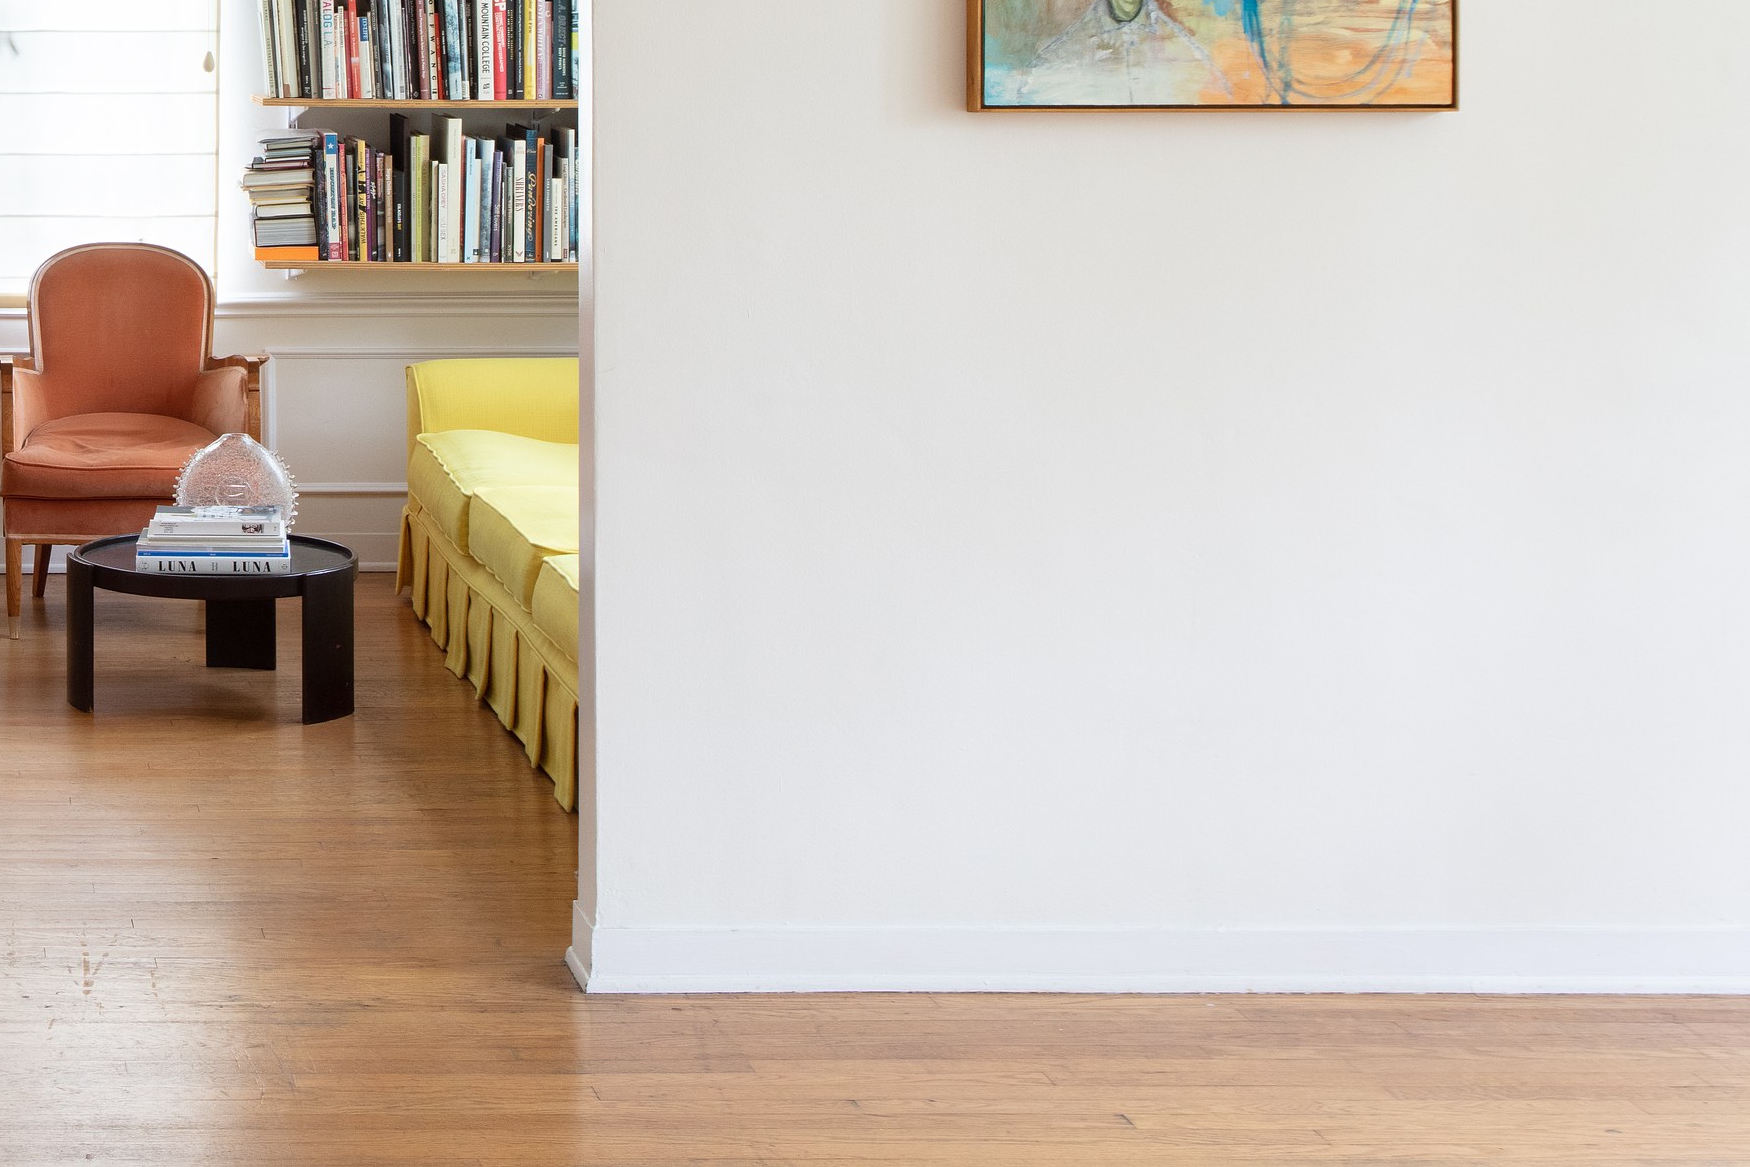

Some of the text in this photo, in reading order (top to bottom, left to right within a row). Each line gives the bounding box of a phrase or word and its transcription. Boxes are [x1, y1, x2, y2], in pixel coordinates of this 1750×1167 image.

[481, 2, 489, 39] MOUNTAIN
[558, 15, 566, 43] OBJECT
[481, 41, 490, 74] COLLEGE
[515, 177, 524, 212] SHRINERS
[526, 171, 537, 242] Pandering
[158, 561, 196, 572] LUNA
[233, 561, 271, 572] LUNA
